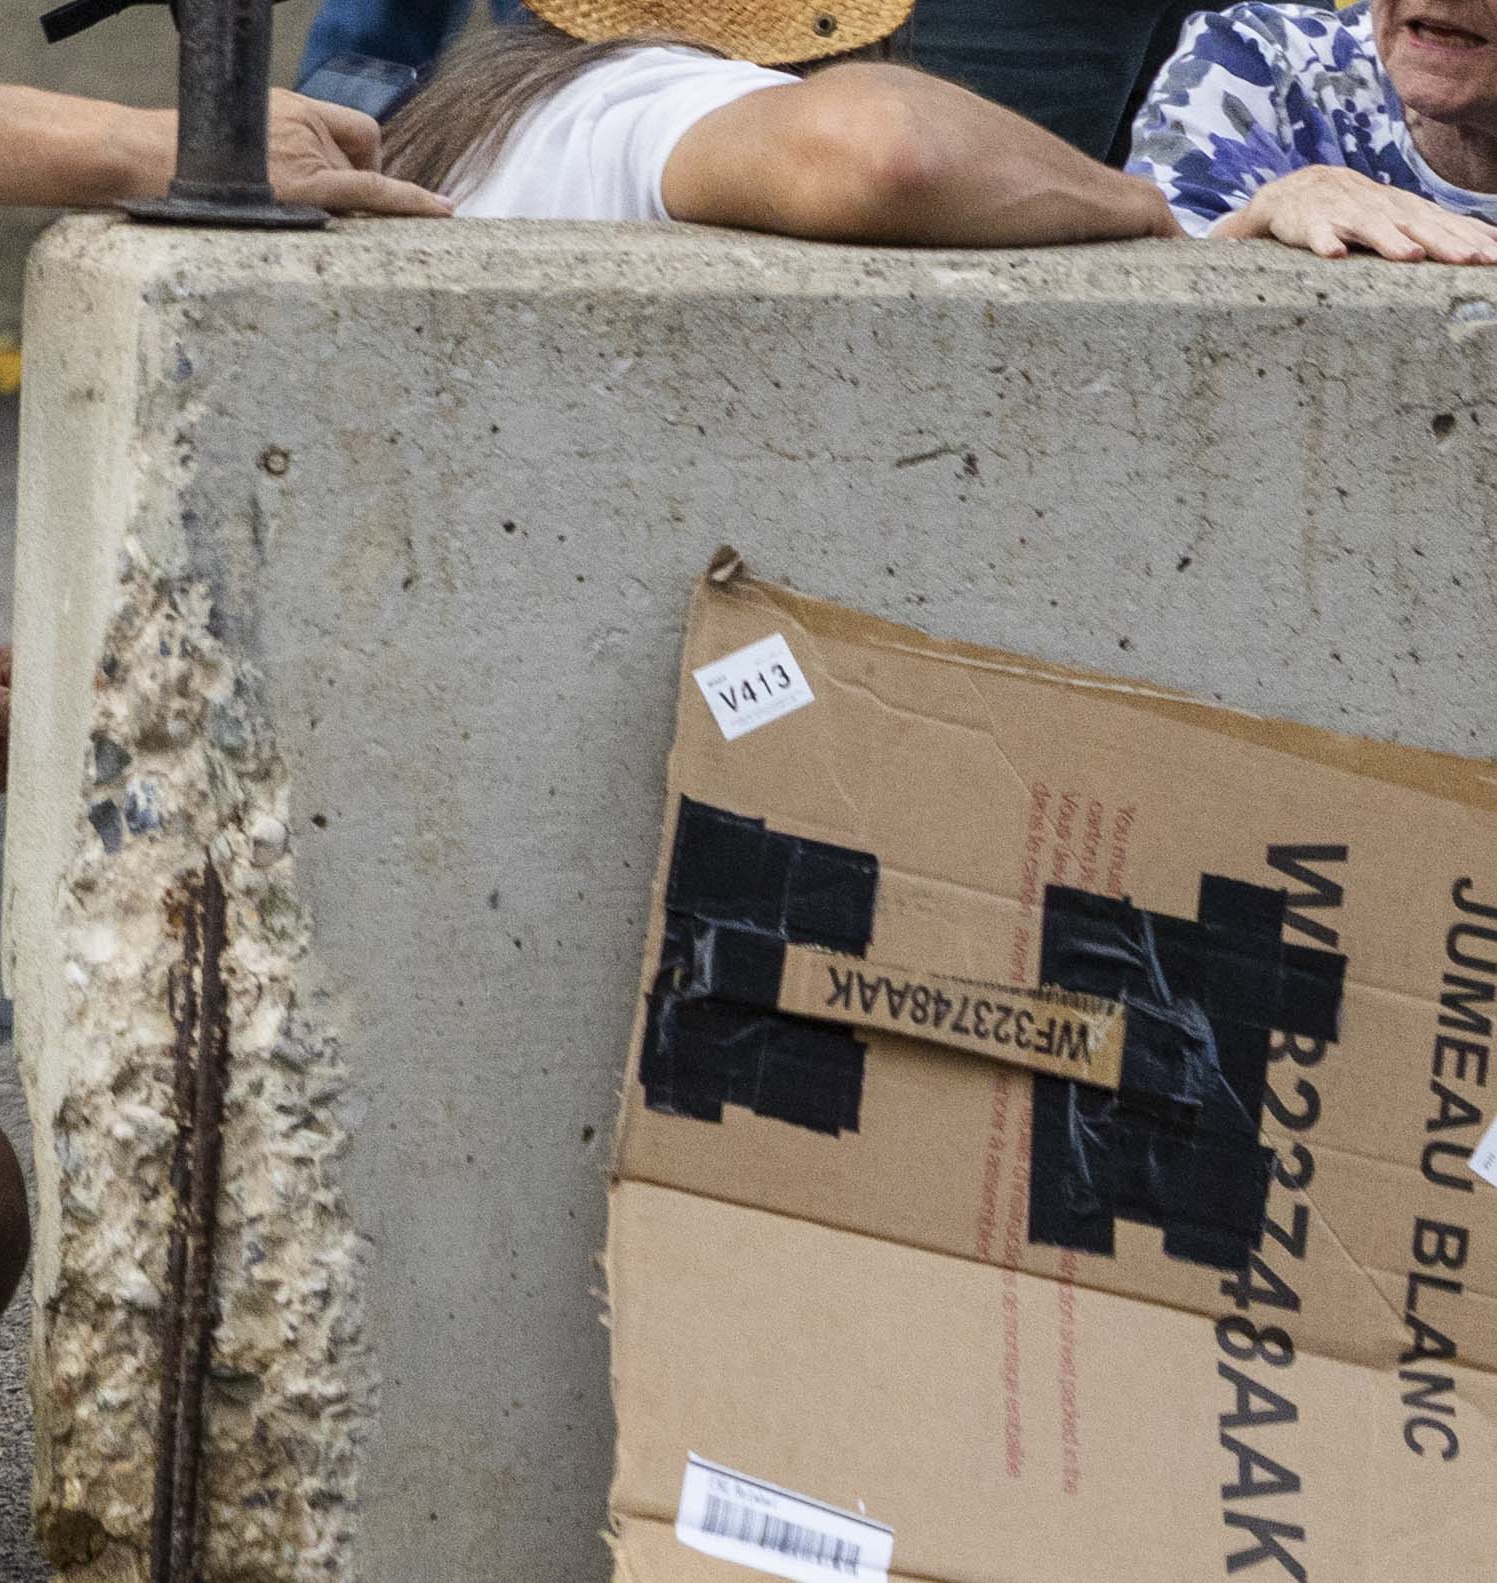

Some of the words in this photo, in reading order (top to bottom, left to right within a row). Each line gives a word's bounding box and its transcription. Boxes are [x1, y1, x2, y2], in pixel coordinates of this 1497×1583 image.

[718, 663, 792, 713] V413
[824, 965, 1092, 1065] WF323748AAK
[1420, 876, 1497, 1193] JUMEAU
[1398, 1215, 1470, 1462] BLANC
